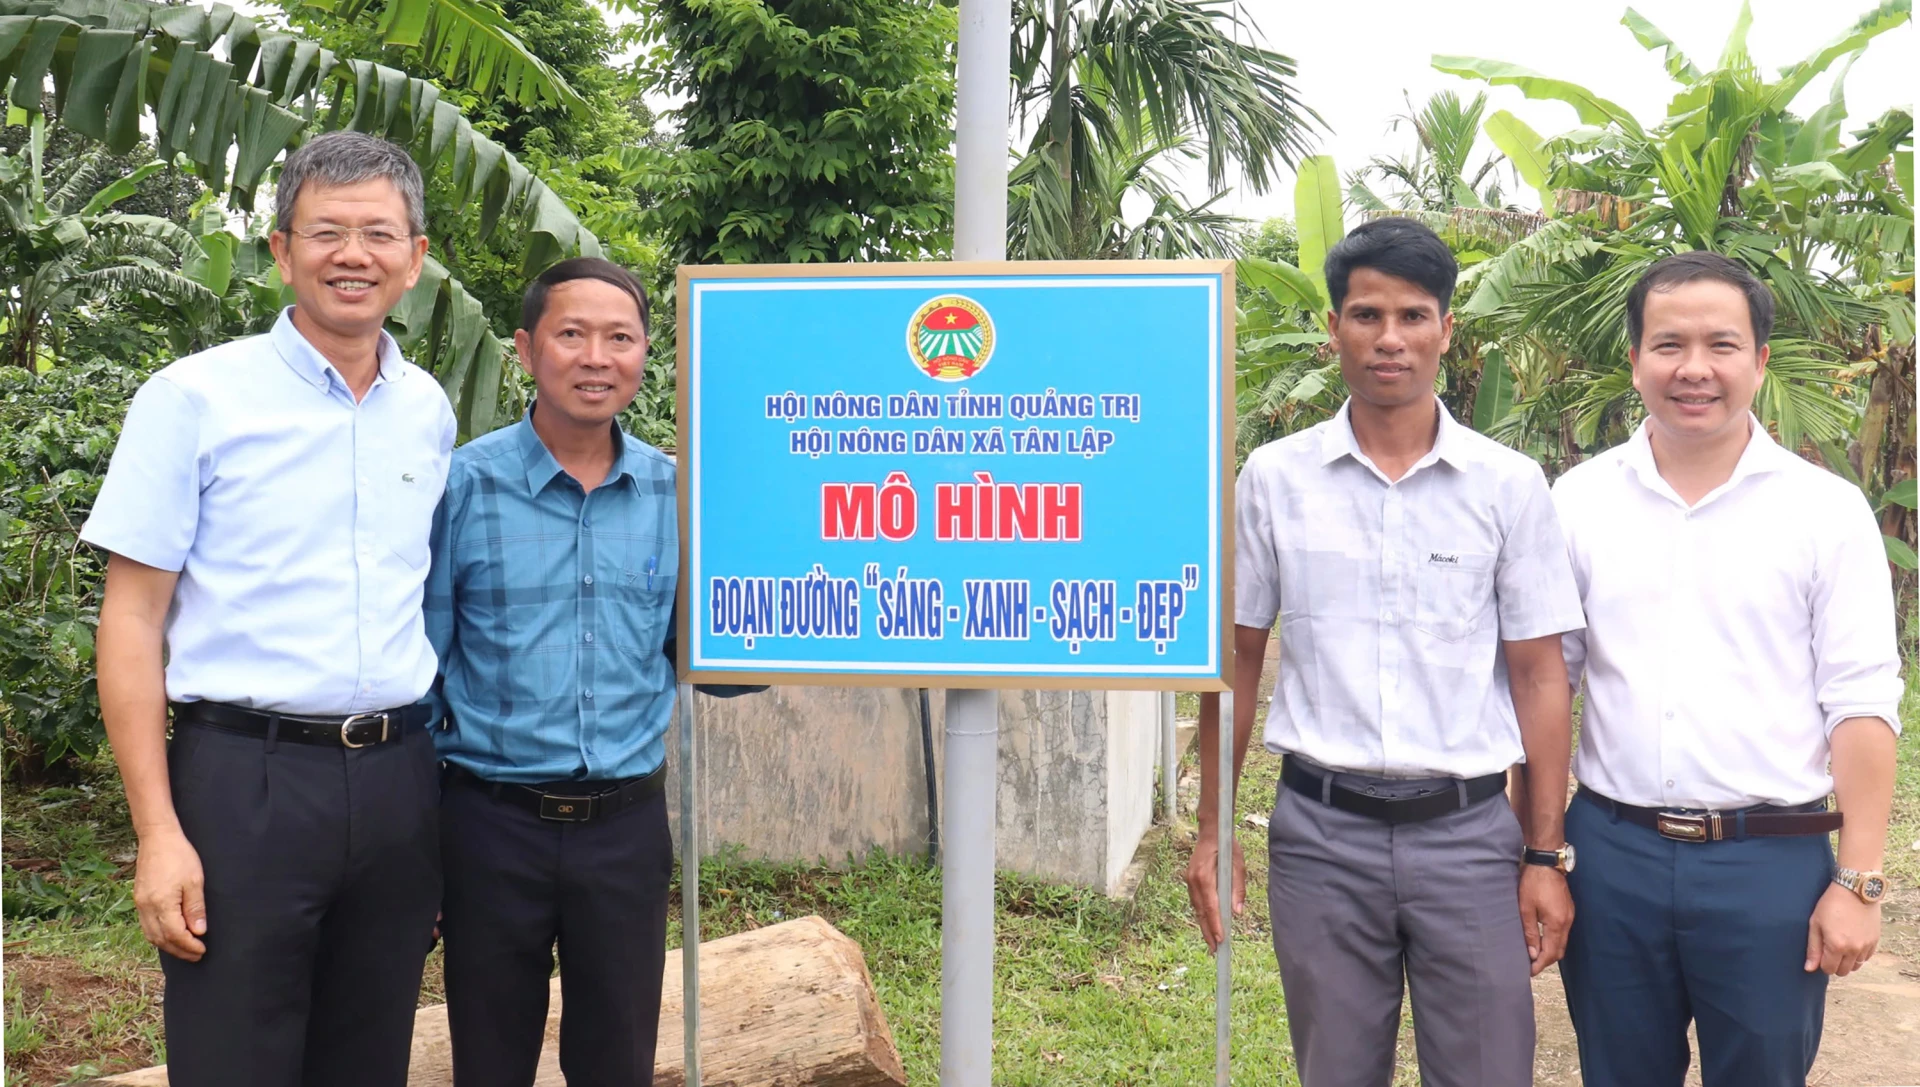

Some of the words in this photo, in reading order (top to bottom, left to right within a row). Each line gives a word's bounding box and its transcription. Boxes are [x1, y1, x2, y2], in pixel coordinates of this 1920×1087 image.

[766, 391, 806, 422] HỘI
[813, 391, 881, 418] NÔNG
[888, 391, 939, 418] DÂN
[946, 389, 1002, 418] TỈNH
[1010, 388, 1094, 420] QUẢNG
[1101, 394, 1140, 422] TRỊ
[791, 427, 831, 458] HỘI
[838, 427, 906, 453] NÔNG
[914, 427, 964, 453] DÂN
[971, 427, 1005, 453] XÃ
[1012, 427, 1060, 453] TÂN
[1067, 427, 1114, 458] LẬP
[822, 471, 917, 541] MÔ
[935, 471, 1083, 541] HÌNH
[711, 577, 775, 648] ĐOẠN
[779, 564, 859, 637] ĐƯỜNG
[963, 580, 1029, 639] XANH
[1050, 580, 1116, 653] SẠCH
